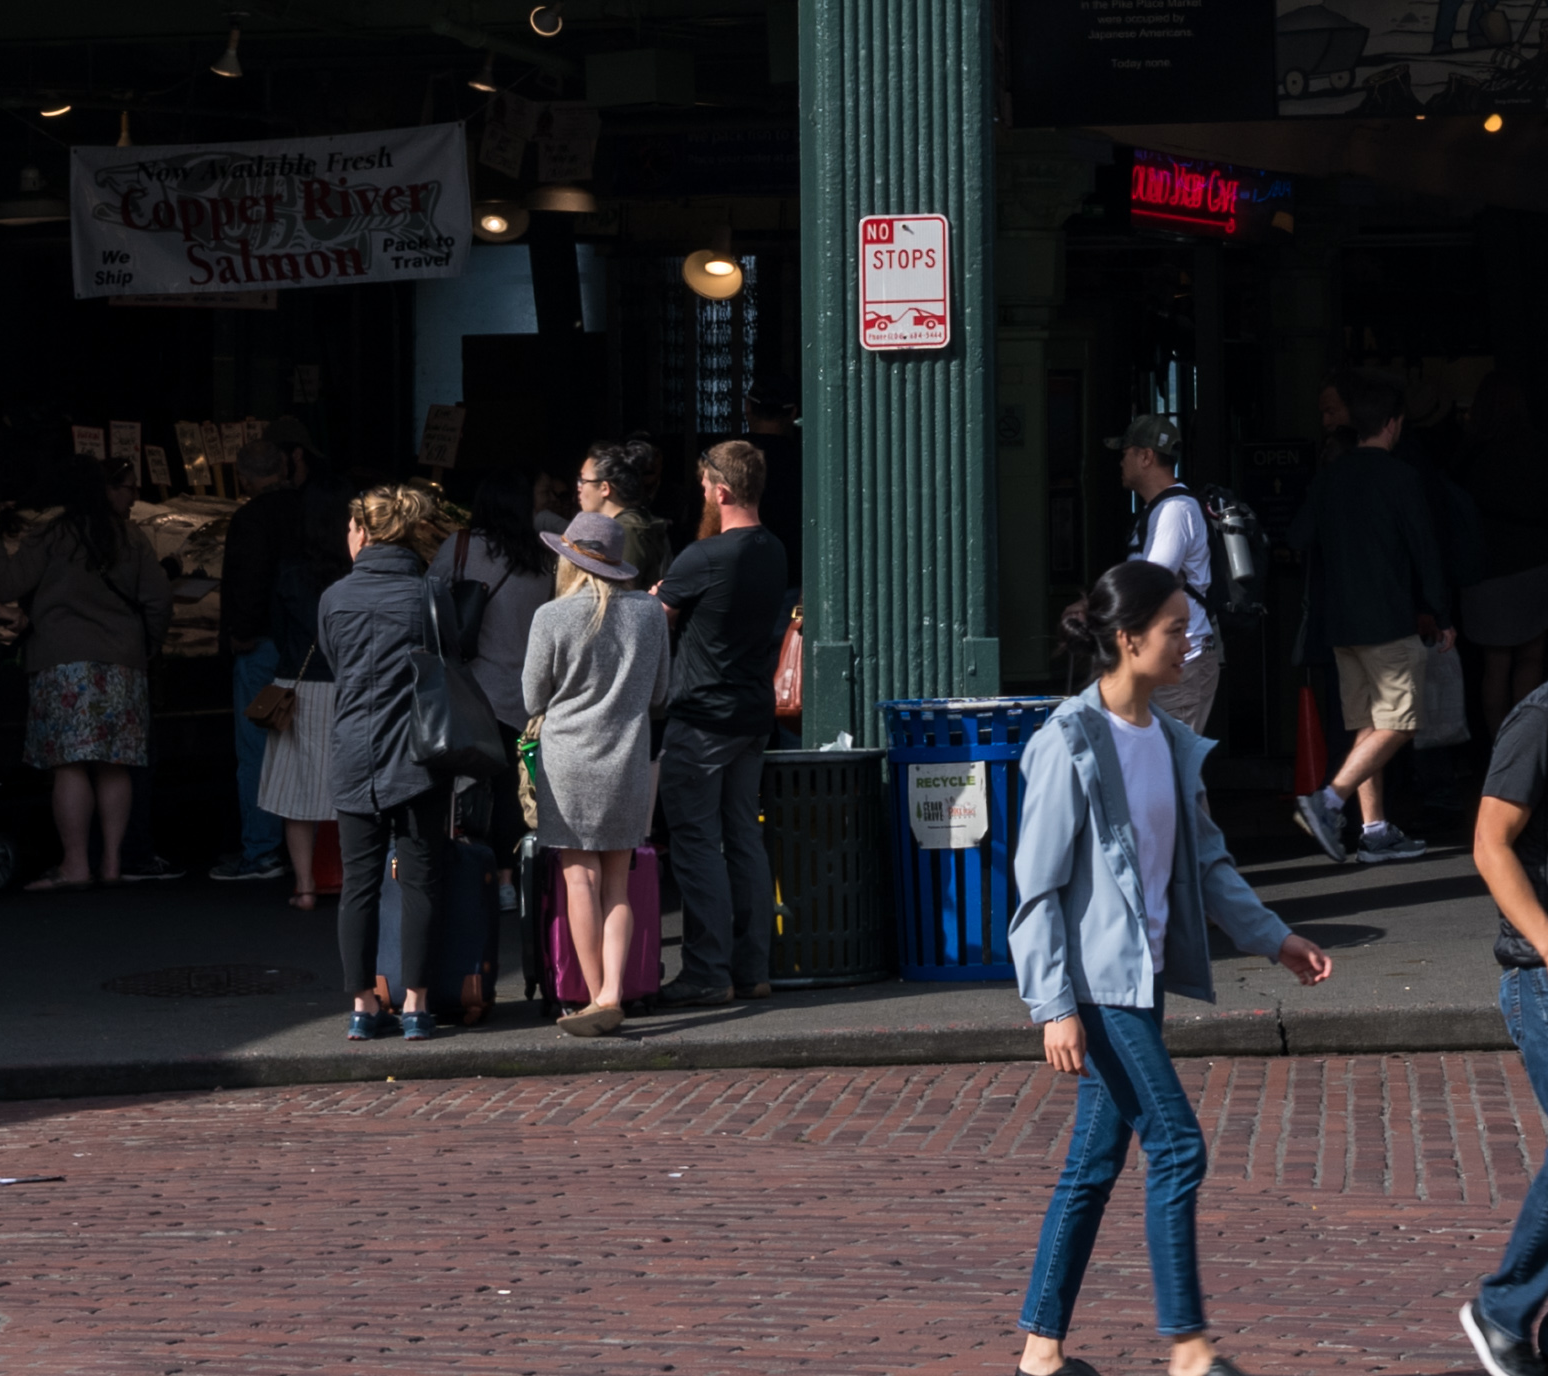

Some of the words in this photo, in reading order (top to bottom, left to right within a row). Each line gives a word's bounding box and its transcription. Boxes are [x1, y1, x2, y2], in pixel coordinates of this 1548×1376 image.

[1111, 0, 1133, 9] Pike
[1136, 0, 1164, 9] Place
[1125, 13, 1170, 26] occupied
[1087, 28, 1137, 41] Japanese
[1111, 58, 1142, 70] Today
[137, 161, 192, 183] Now
[199, 154, 317, 182] Available
[326, 146, 394, 174] Fresh
[120, 186, 283, 243] Copper
[302, 176, 430, 221] River
[866, 222, 889, 241] NO
[382, 236, 429, 253] Pack
[437, 234, 455, 249] to
[101, 251, 131, 265] We
[185, 238, 368, 285] Salmon
[391, 254, 452, 270] Travel
[872, 248, 937, 270] STOPS
[94, 270, 134, 288] Ship
[1252, 450, 1300, 466] OPEN
[916, 775, 976, 788] RECYCLE
